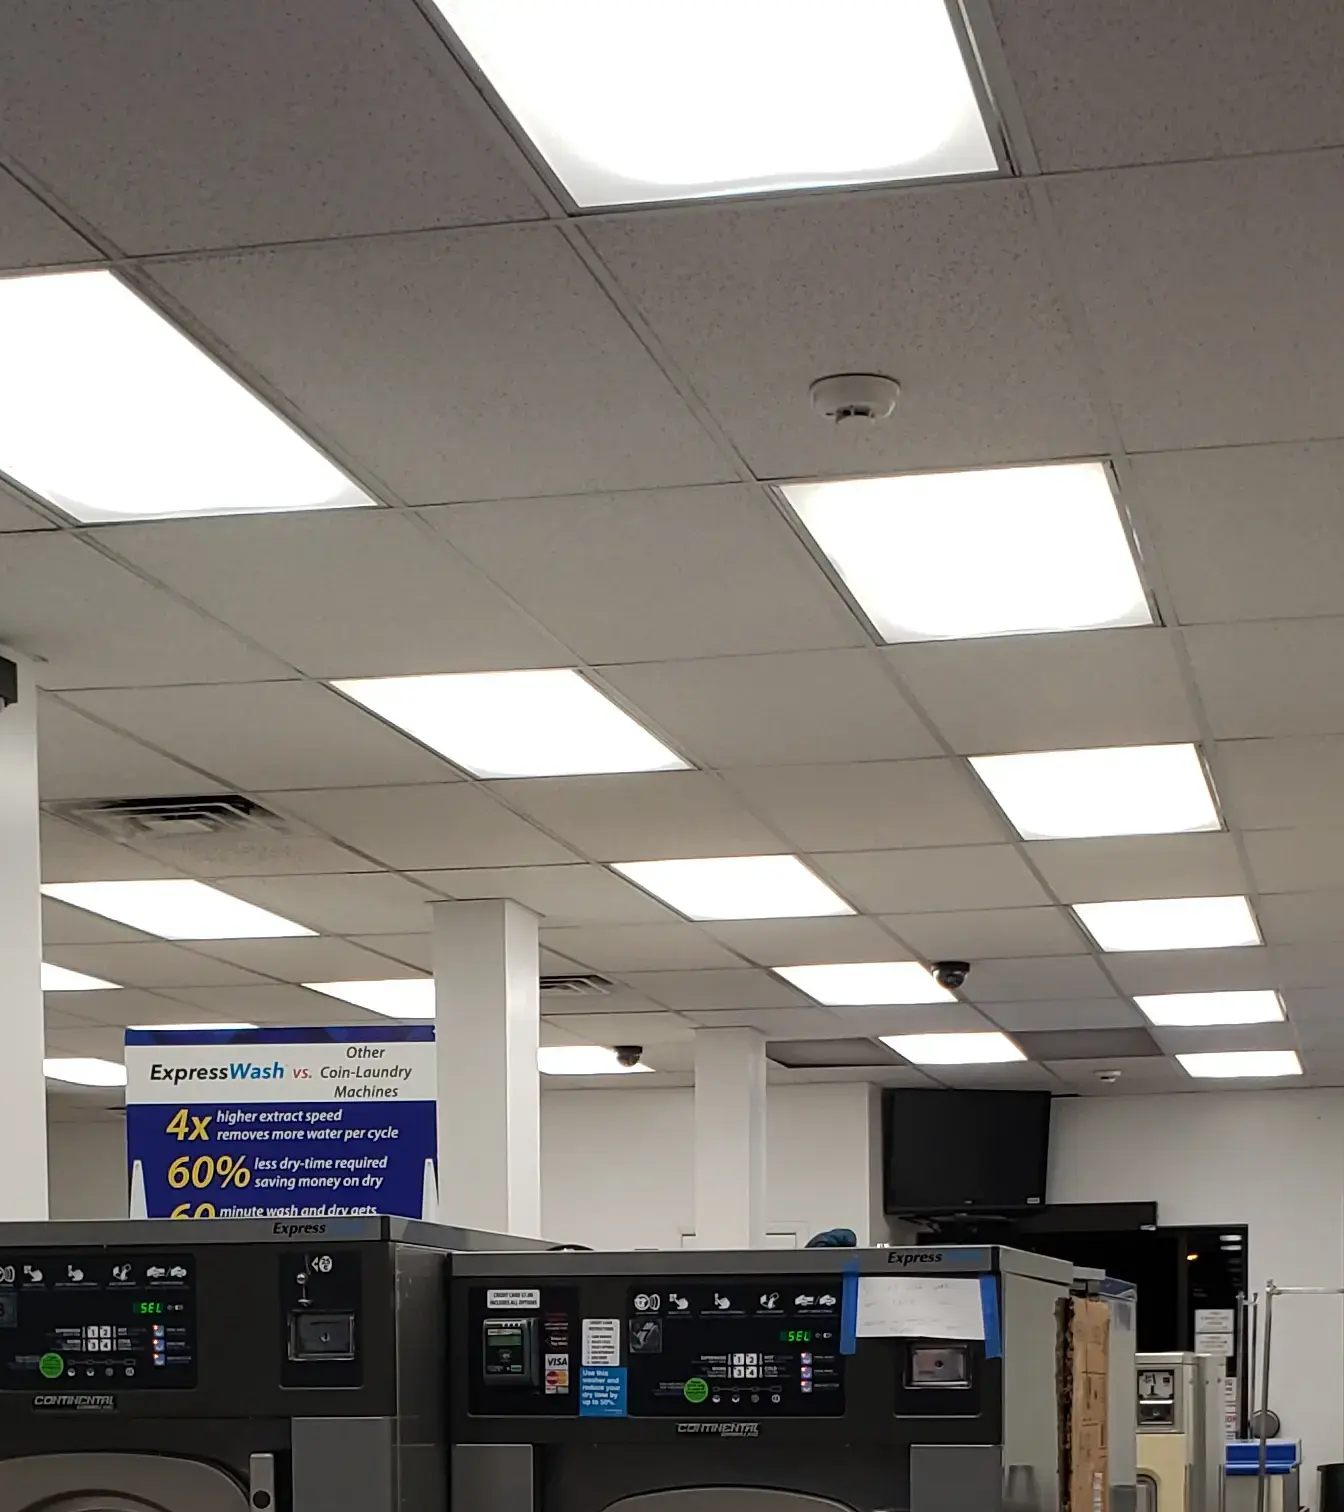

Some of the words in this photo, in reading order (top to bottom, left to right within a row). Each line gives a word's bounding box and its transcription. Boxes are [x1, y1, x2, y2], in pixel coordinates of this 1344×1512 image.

[346, 1046, 385, 1060] Other
[150, 1062, 284, 1085] ExpressWash
[293, 1067, 312, 1079] vs.
[320, 1065, 412, 1082] Coin-Laundry
[334, 1085, 398, 1099] Machines
[216, 1109, 257, 1125] higher
[259, 1110, 303, 1122] extract
[305, 1109, 342, 1124] speed
[166, 1109, 212, 1141] 4x
[216, 1129, 269, 1141] removes
[272, 1129, 304, 1140] more
[306, 1127, 343, 1139] water
[345, 1128, 366, 1143] per
[367, 1126, 399, 1142] cycle
[167, 1155, 251, 1189] 60%
[254, 1157, 278, 1171] less
[279, 1158, 333, 1173] dry-time
[334, 1156, 388, 1172] required
[254, 1176, 296, 1191] saving
[298, 1176, 341, 1190] money
[342, 1176, 359, 1187] on
[361, 1174, 383, 1190] dry
[220, 1203, 264, 1217] minute
[266, 1204, 298, 1217] wash
[301, 1203, 325, 1216] and
[273, 1222, 327, 1237] Express
[888, 1252, 942, 1267] Express
[787, 1330, 811, 1343] SEL
[547, 1357, 567, 1366] VISA
